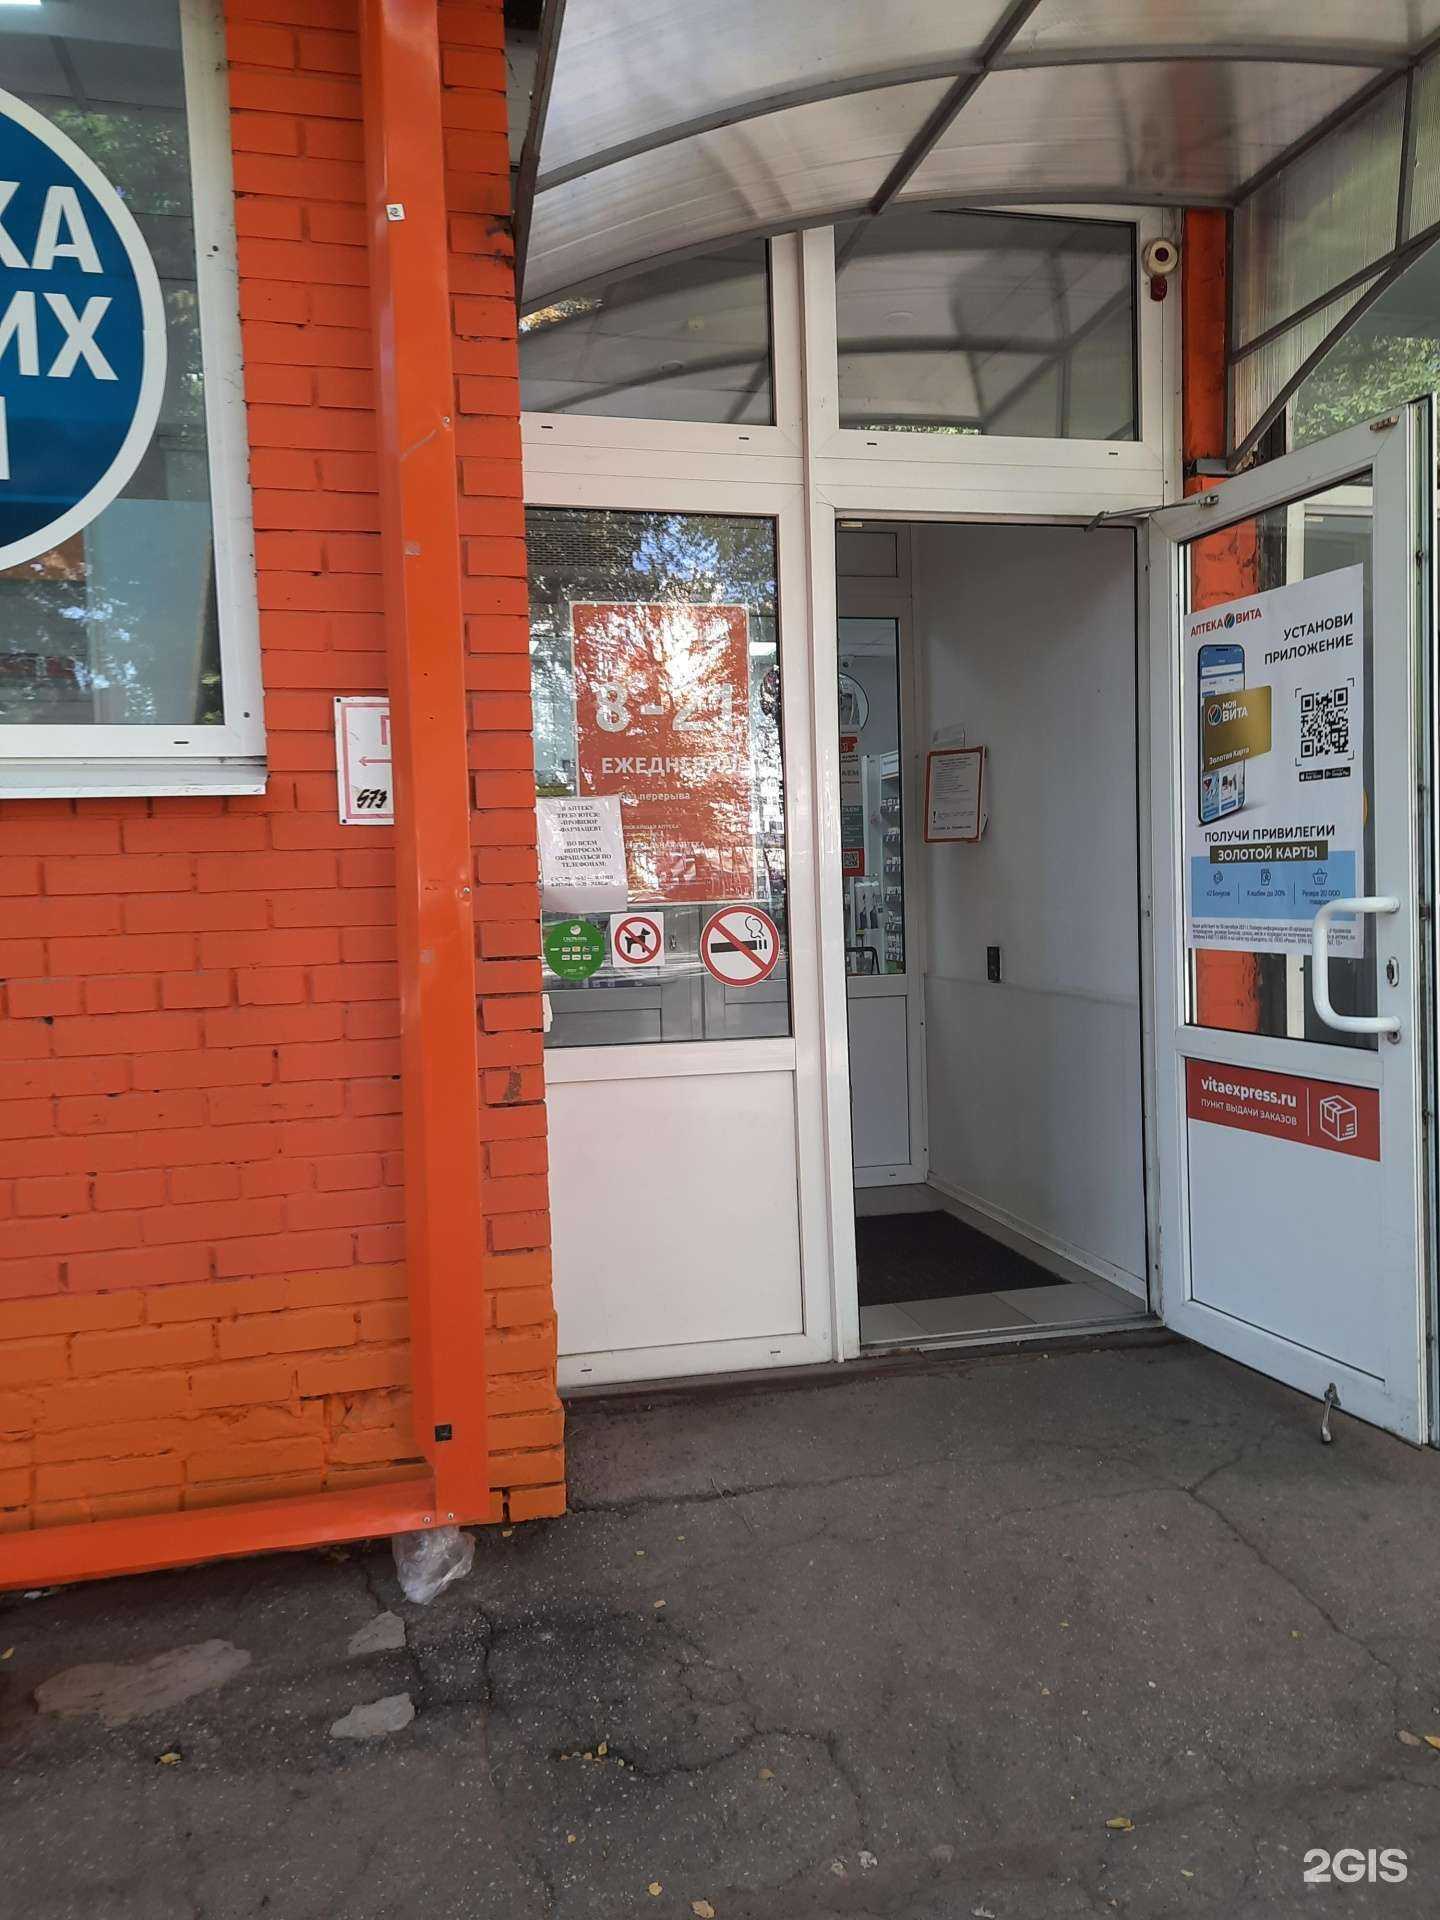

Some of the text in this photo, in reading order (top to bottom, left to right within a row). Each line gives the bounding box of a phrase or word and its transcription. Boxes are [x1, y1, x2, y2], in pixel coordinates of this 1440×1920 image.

[1190, 608, 1262, 637] АПТЕКА ВИТА
[1283, 612, 1353, 641] УСТАНОВИ
[1264, 633, 1354, 665] ПРИЛОЖЕНИЕ
[1222, 707, 1248, 722] ВИТА
[639, 792, 691, 801] перерыва
[1204, 825, 1335, 843] ПОЛУЧИ ПРИВИЛЕГИИ
[1218, 845, 1318, 861] ЗОЛОТОЙ КАРТЫ
[1201, 1076, 1297, 1108] vitaexpress.ru
[1201, 1098, 1297, 1126] ПУНКТ ВЫДАЧИ ЗАКАЗОВ
